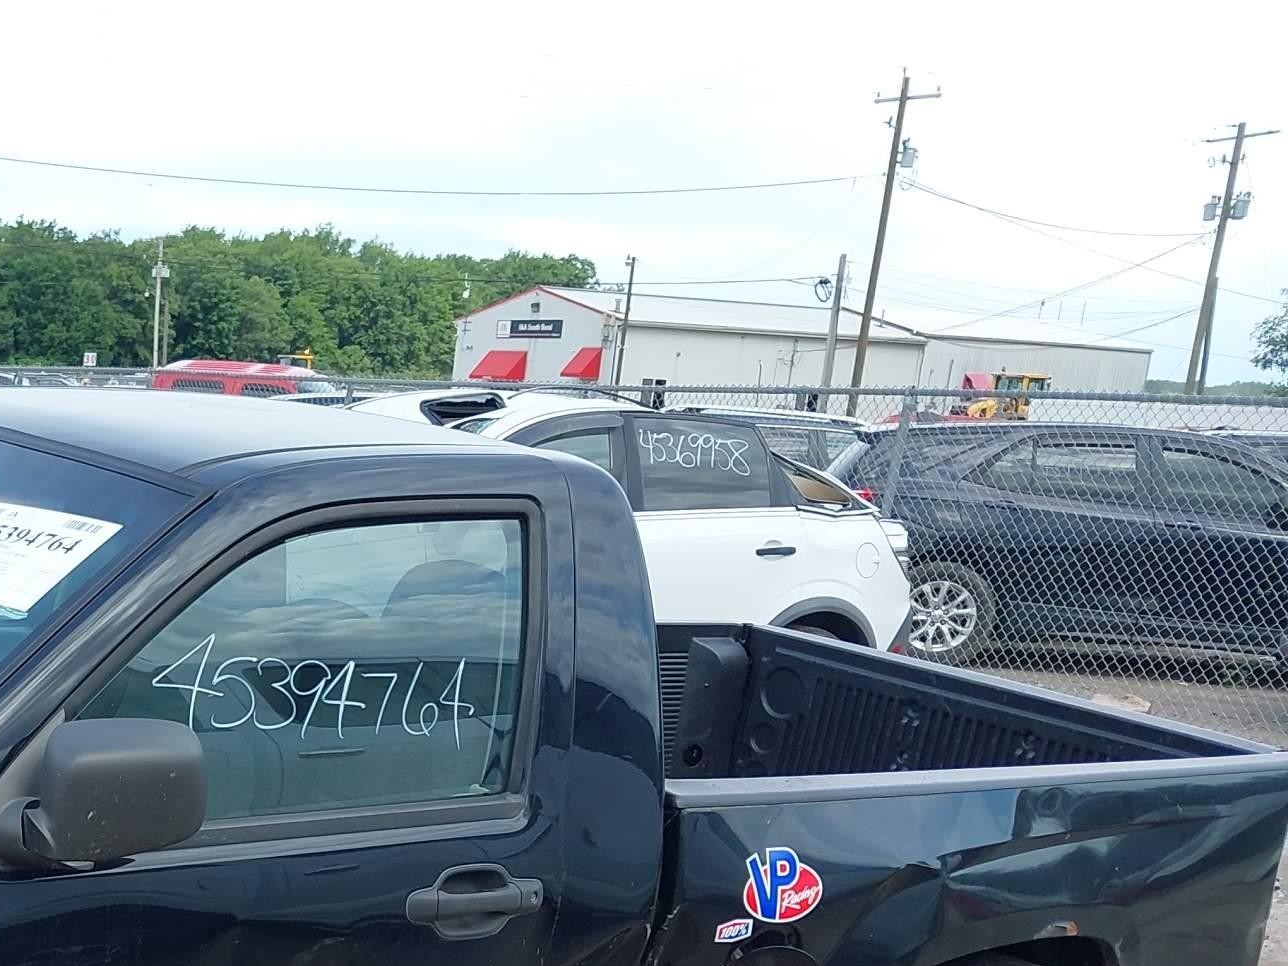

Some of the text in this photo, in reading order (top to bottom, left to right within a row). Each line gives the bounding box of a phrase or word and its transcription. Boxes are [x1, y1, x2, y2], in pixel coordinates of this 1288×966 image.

[638, 428, 751, 476] 45369958
[152, 632, 476, 752] 45394764
[745, 847, 800, 921] VP
[781, 885, 821, 913] Racing
[719, 923, 748, 940] 100%
